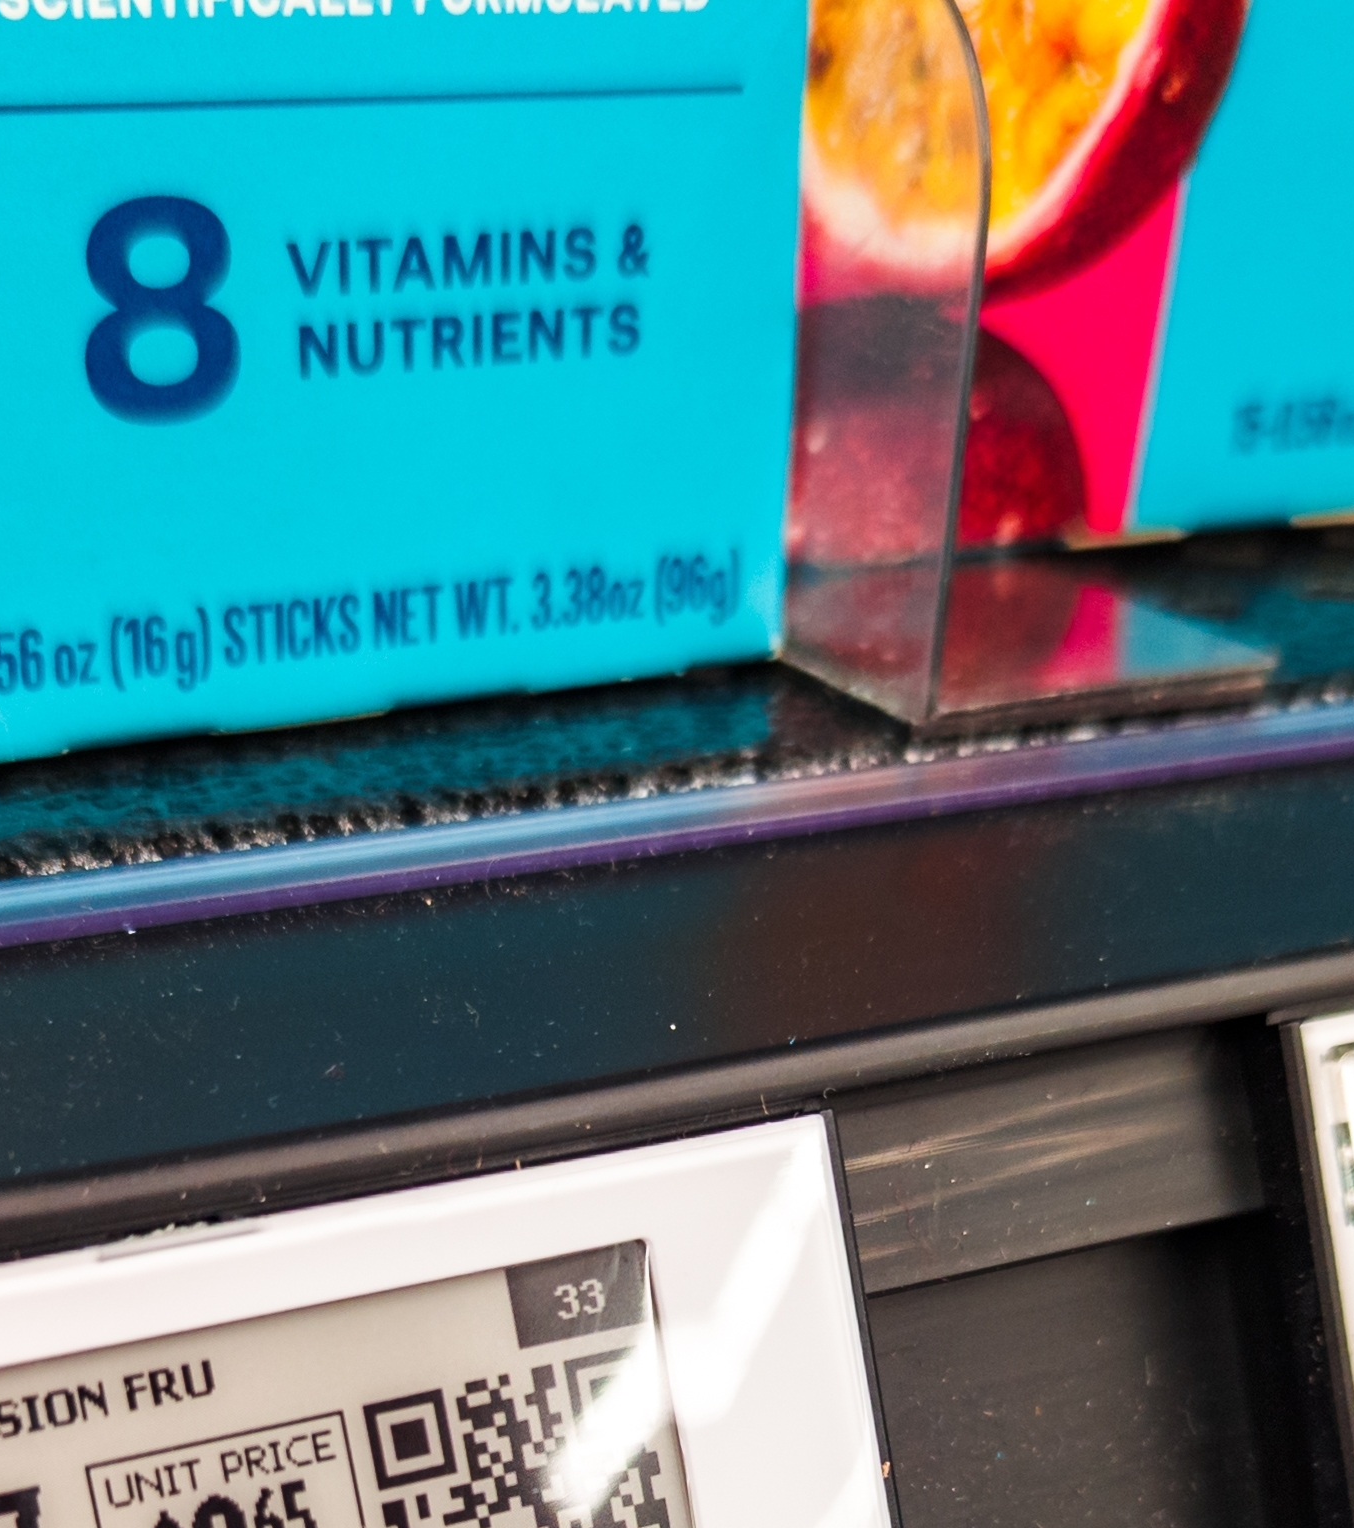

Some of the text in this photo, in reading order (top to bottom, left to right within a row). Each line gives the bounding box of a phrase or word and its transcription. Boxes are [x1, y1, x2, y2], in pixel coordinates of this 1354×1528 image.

[286, 222, 651, 298] VITAMINS &
[84, 195, 243, 427] 8
[296, 303, 643, 381] NUTRIENTS
[110, 605, 212, 693] (16g)
[222, 593, 361, 668] STICKS
[371, 584, 444, 652] NET
[453, 575, 520, 641] WT.
[529, 563, 646, 631] 3.38oz
[654, 546, 744, 625] (96g)
[553, 1278, 607, 1320] 33
[123, 1359, 216, 1412] FRU
[106, 1428, 337, 1509] UNIT PRICE
